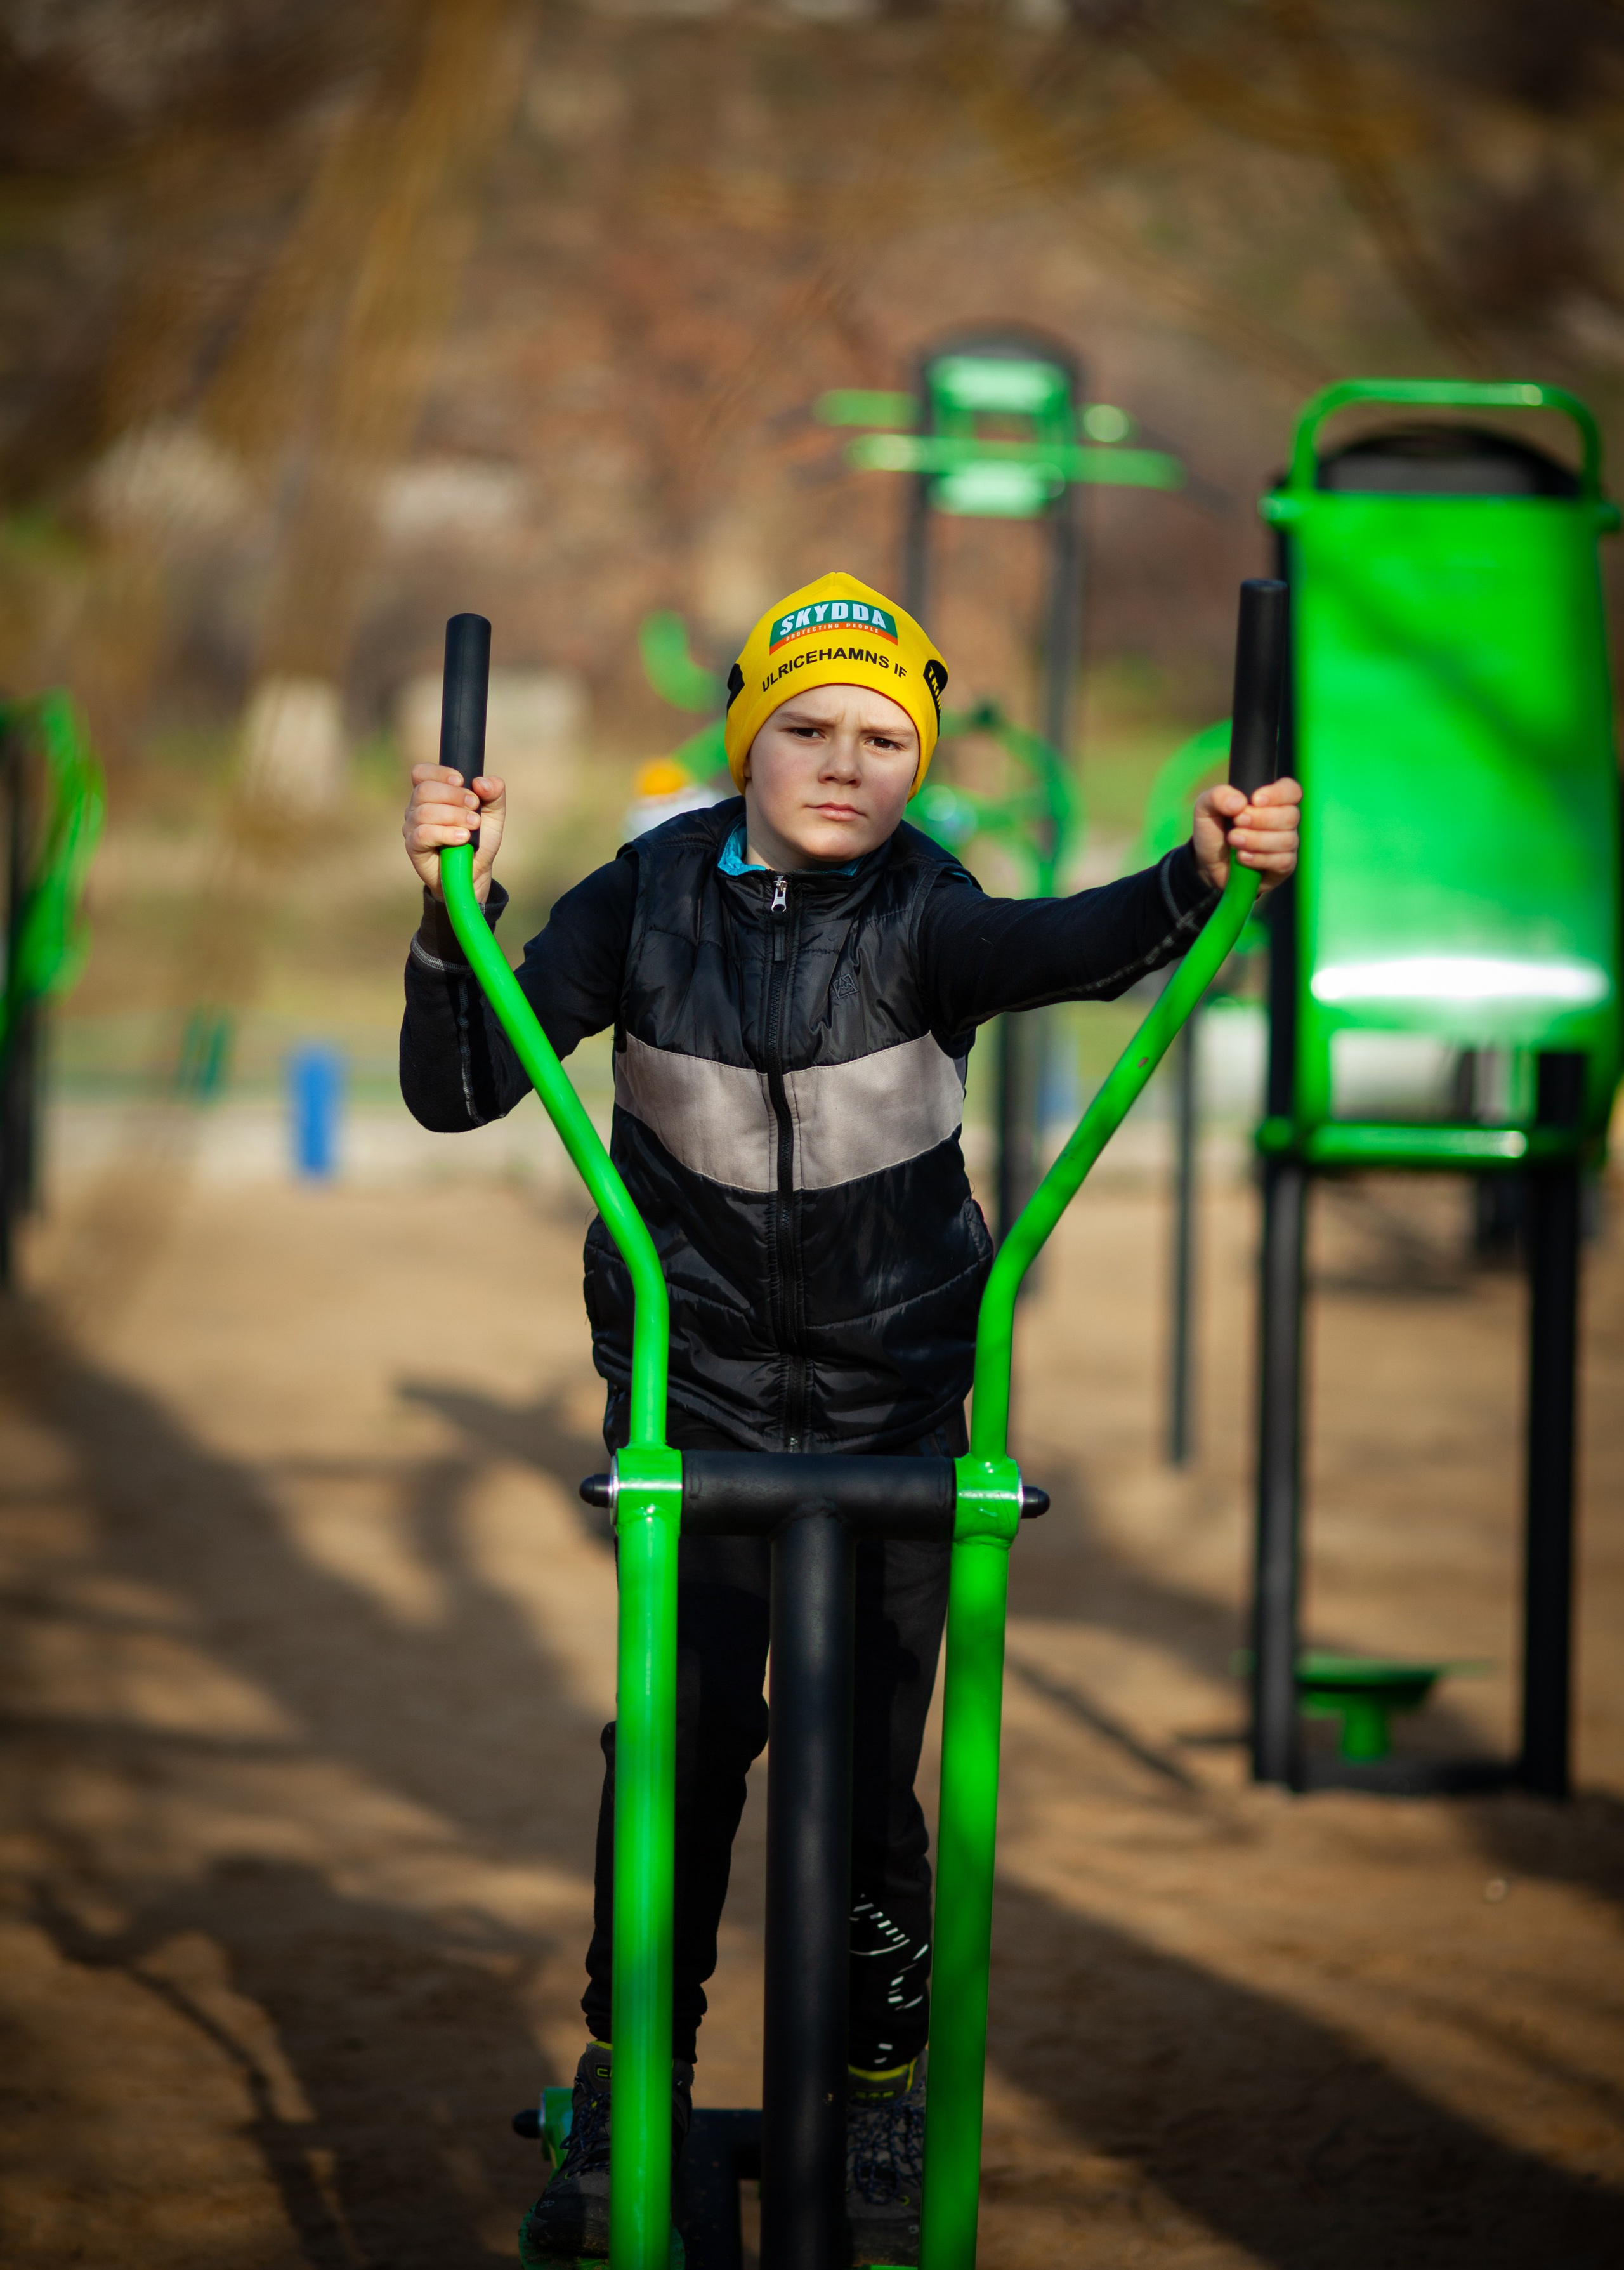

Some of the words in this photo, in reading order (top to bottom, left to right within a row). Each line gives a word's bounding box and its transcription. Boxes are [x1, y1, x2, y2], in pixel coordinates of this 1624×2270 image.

[780, 602, 887, 636] SKYDDA
[786, 623, 839, 642] PROTECTING
[846, 622, 879, 634] PEOPLE
[762, 647, 889, 692] ULRICEHAMNS
[894, 662, 908, 678] IF
